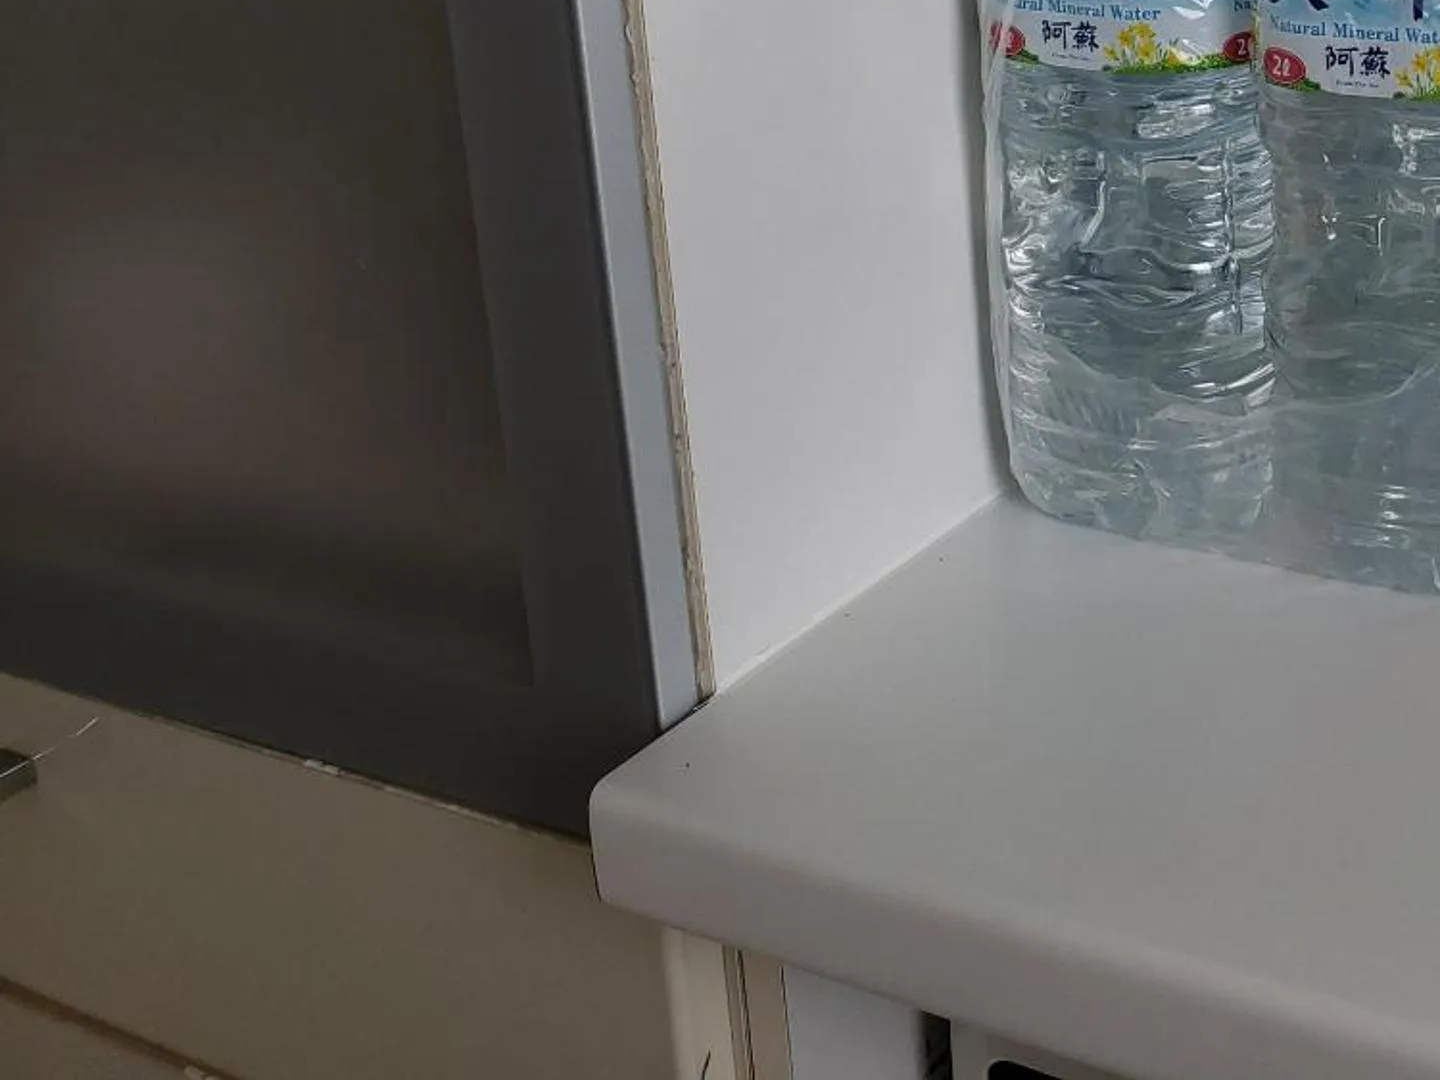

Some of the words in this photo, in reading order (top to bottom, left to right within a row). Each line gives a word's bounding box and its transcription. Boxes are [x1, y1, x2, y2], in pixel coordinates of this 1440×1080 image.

[1110, 4, 1162, 21] Water
[1270, 16, 1326, 37] Natural
[1332, 21, 1400, 44] Mineral
[1325, 45, 1392, 77] 阿蘇
